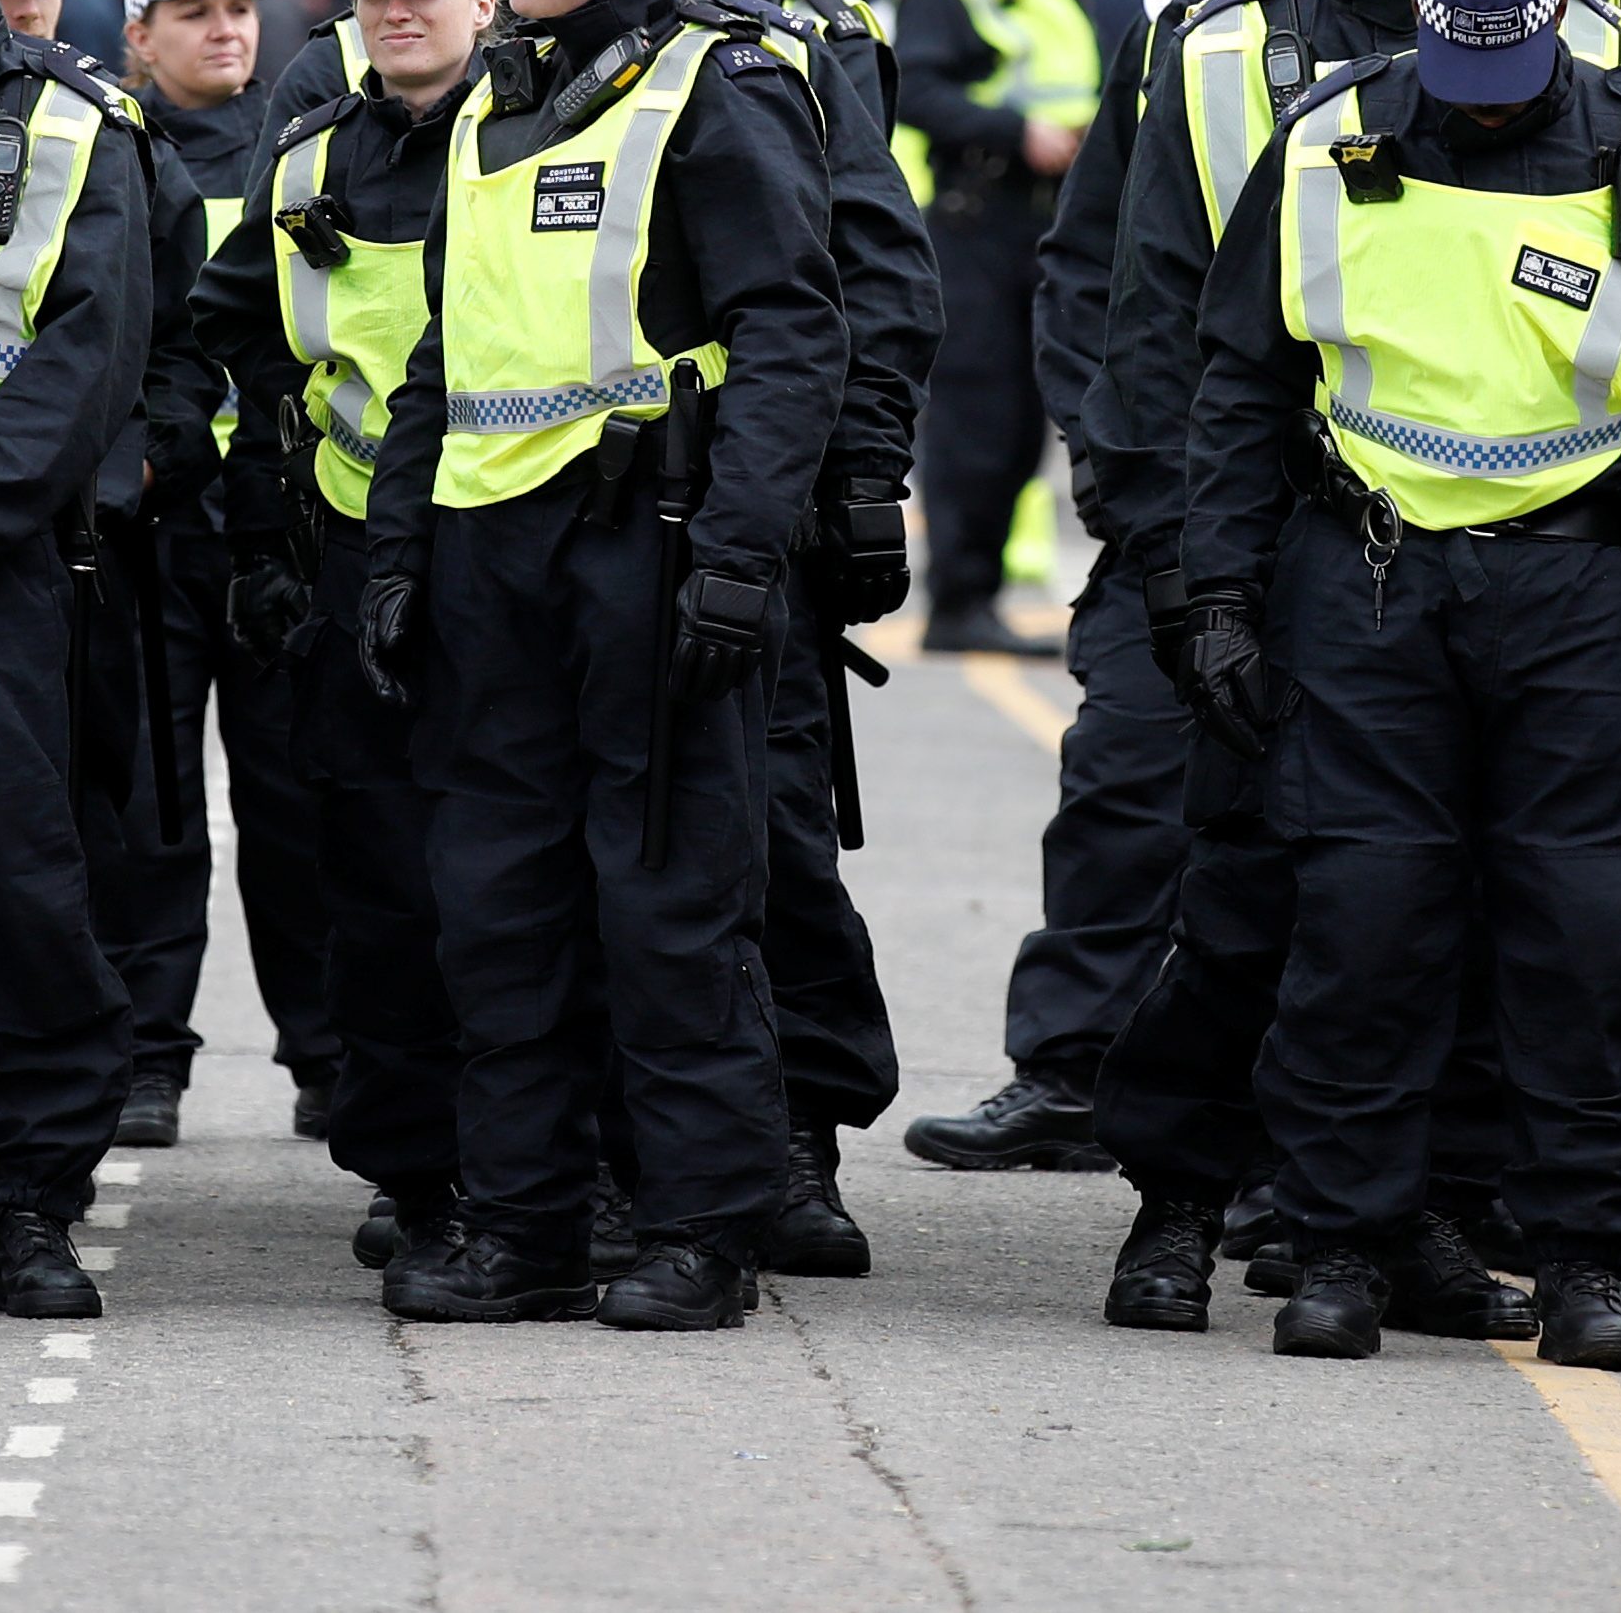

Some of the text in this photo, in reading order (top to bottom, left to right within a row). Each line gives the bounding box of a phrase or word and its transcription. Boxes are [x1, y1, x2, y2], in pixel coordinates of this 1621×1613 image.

[1482, 21, 1512, 30] POLICE
[1452, 30, 1522, 46] POLICE OFFICER
[549, 166, 590, 177] CONSTABLE
[562, 200, 590, 210] POLICE
[536, 214, 598, 226] POLICE OFFICER
[1551, 269, 1582, 287] POLICE
[1518, 271, 1588, 303] POLICE OFFICER
